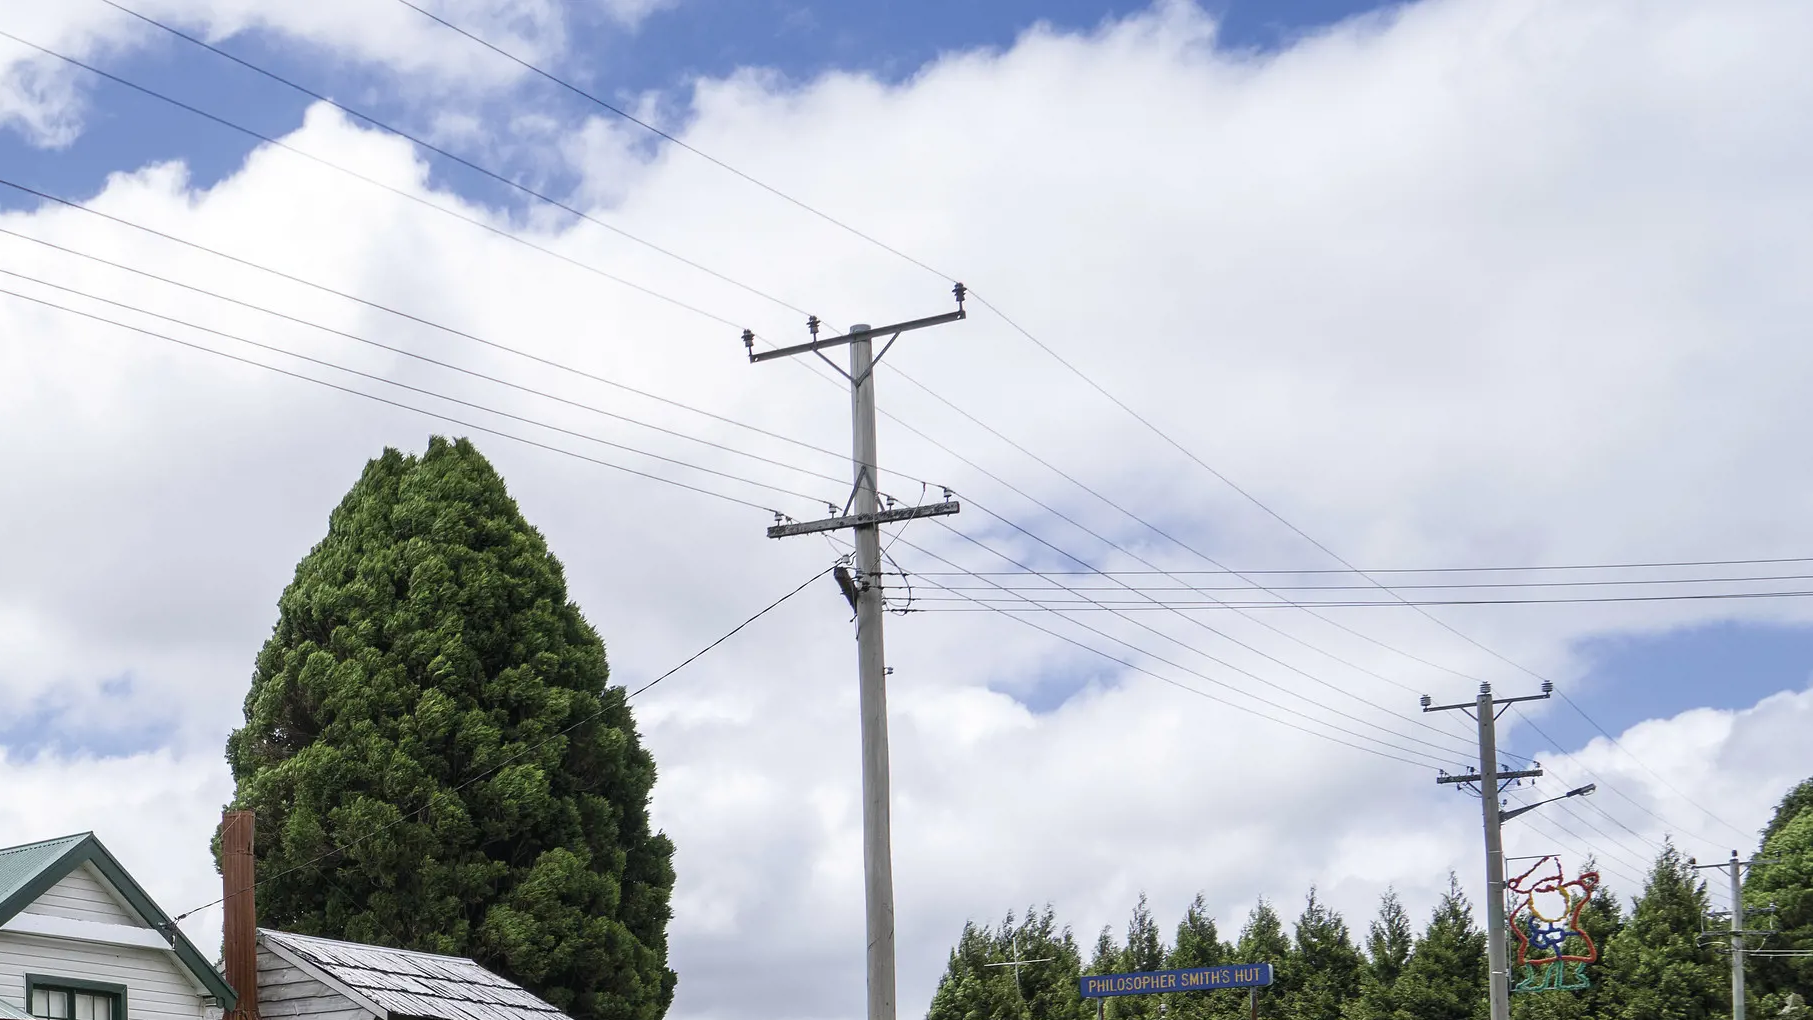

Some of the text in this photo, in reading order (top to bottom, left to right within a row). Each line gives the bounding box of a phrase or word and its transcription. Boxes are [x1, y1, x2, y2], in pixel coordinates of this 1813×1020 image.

[1088, 967, 1261, 993] PHILOSOPHER SMITH'S HUT
